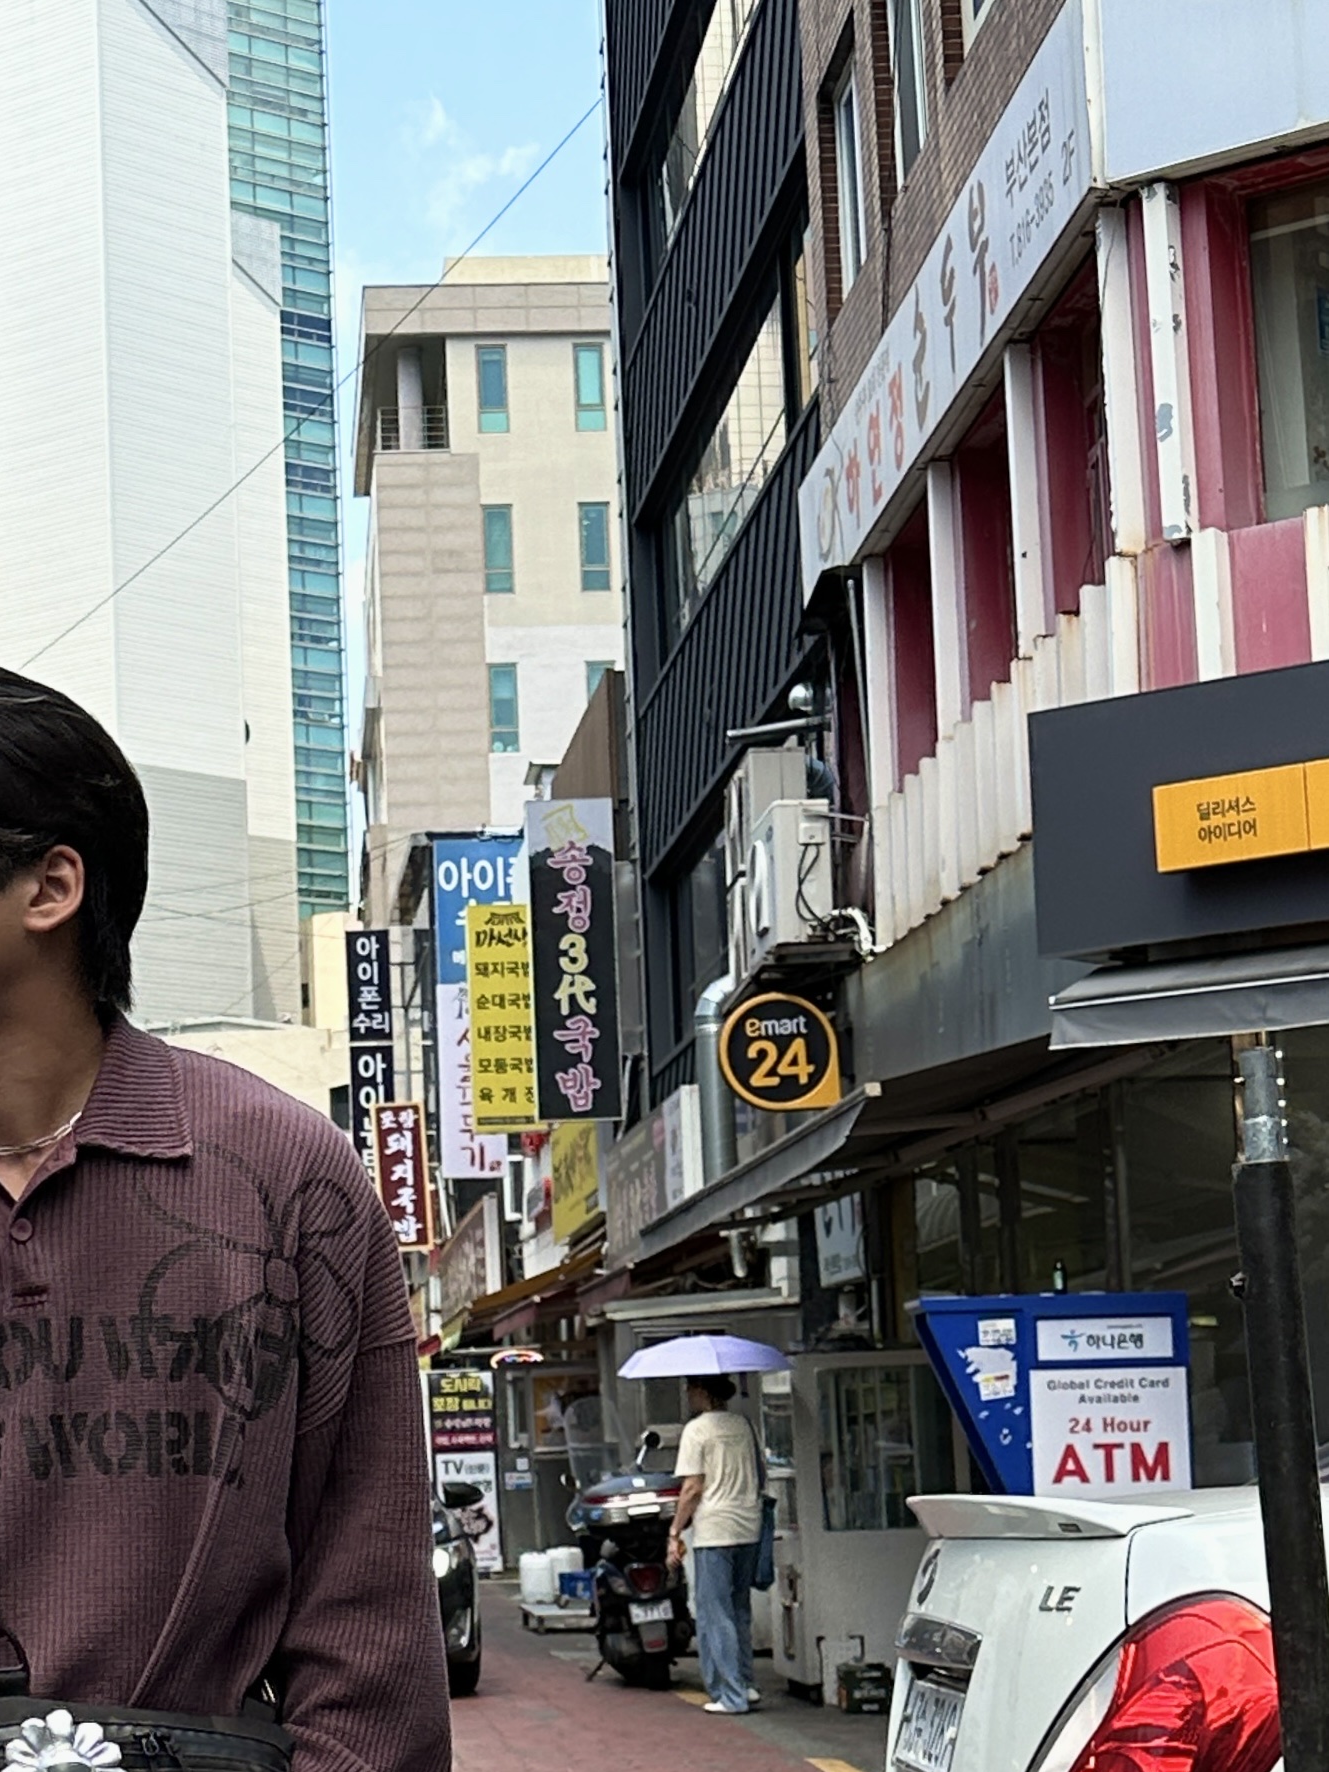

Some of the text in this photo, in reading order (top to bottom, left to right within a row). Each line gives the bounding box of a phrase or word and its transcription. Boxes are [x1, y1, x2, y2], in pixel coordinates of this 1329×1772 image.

[1005, 88, 1051, 208] 부산본점
[1196, 796, 1257, 821] 딜리셔스
[1198, 817, 1258, 844] 아이디어
[745, 1014, 808, 1038] emart
[747, 1037, 815, 1088] 24
[384, 1130, 423, 1243] 돼지국밥
[1085, 1333, 1144, 1349] 하나은행
[1046, 1377, 1171, 1391] Global Credit Card
[1077, 1392, 1141, 1405] Available
[1068, 1416, 1152, 1434] 24 Hour
[1052, 1441, 1172, 1485] ATM
[1037, 1585, 1082, 1612] LE
